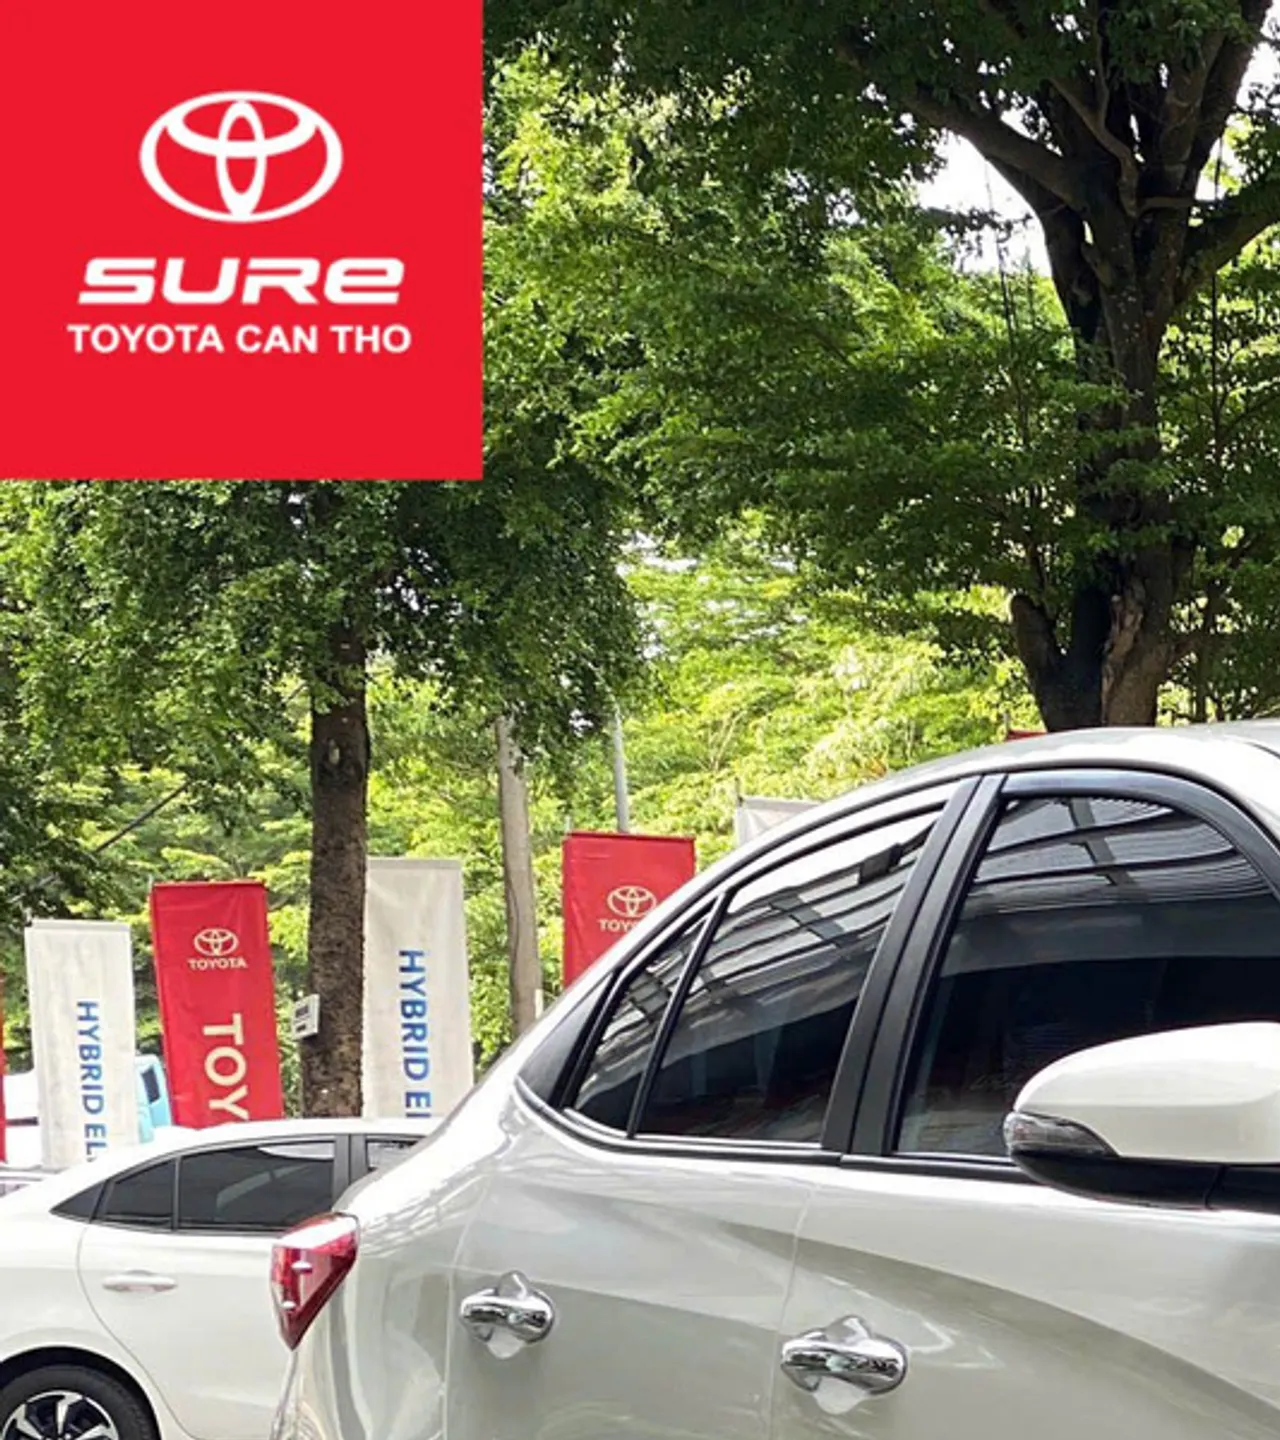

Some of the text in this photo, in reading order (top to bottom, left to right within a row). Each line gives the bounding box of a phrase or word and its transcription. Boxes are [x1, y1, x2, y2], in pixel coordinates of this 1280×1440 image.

[187, 958, 248, 970] TOYOTA
[398, 949, 431, 1081] HYBRID
[76, 1000, 106, 1115] HYBRID
